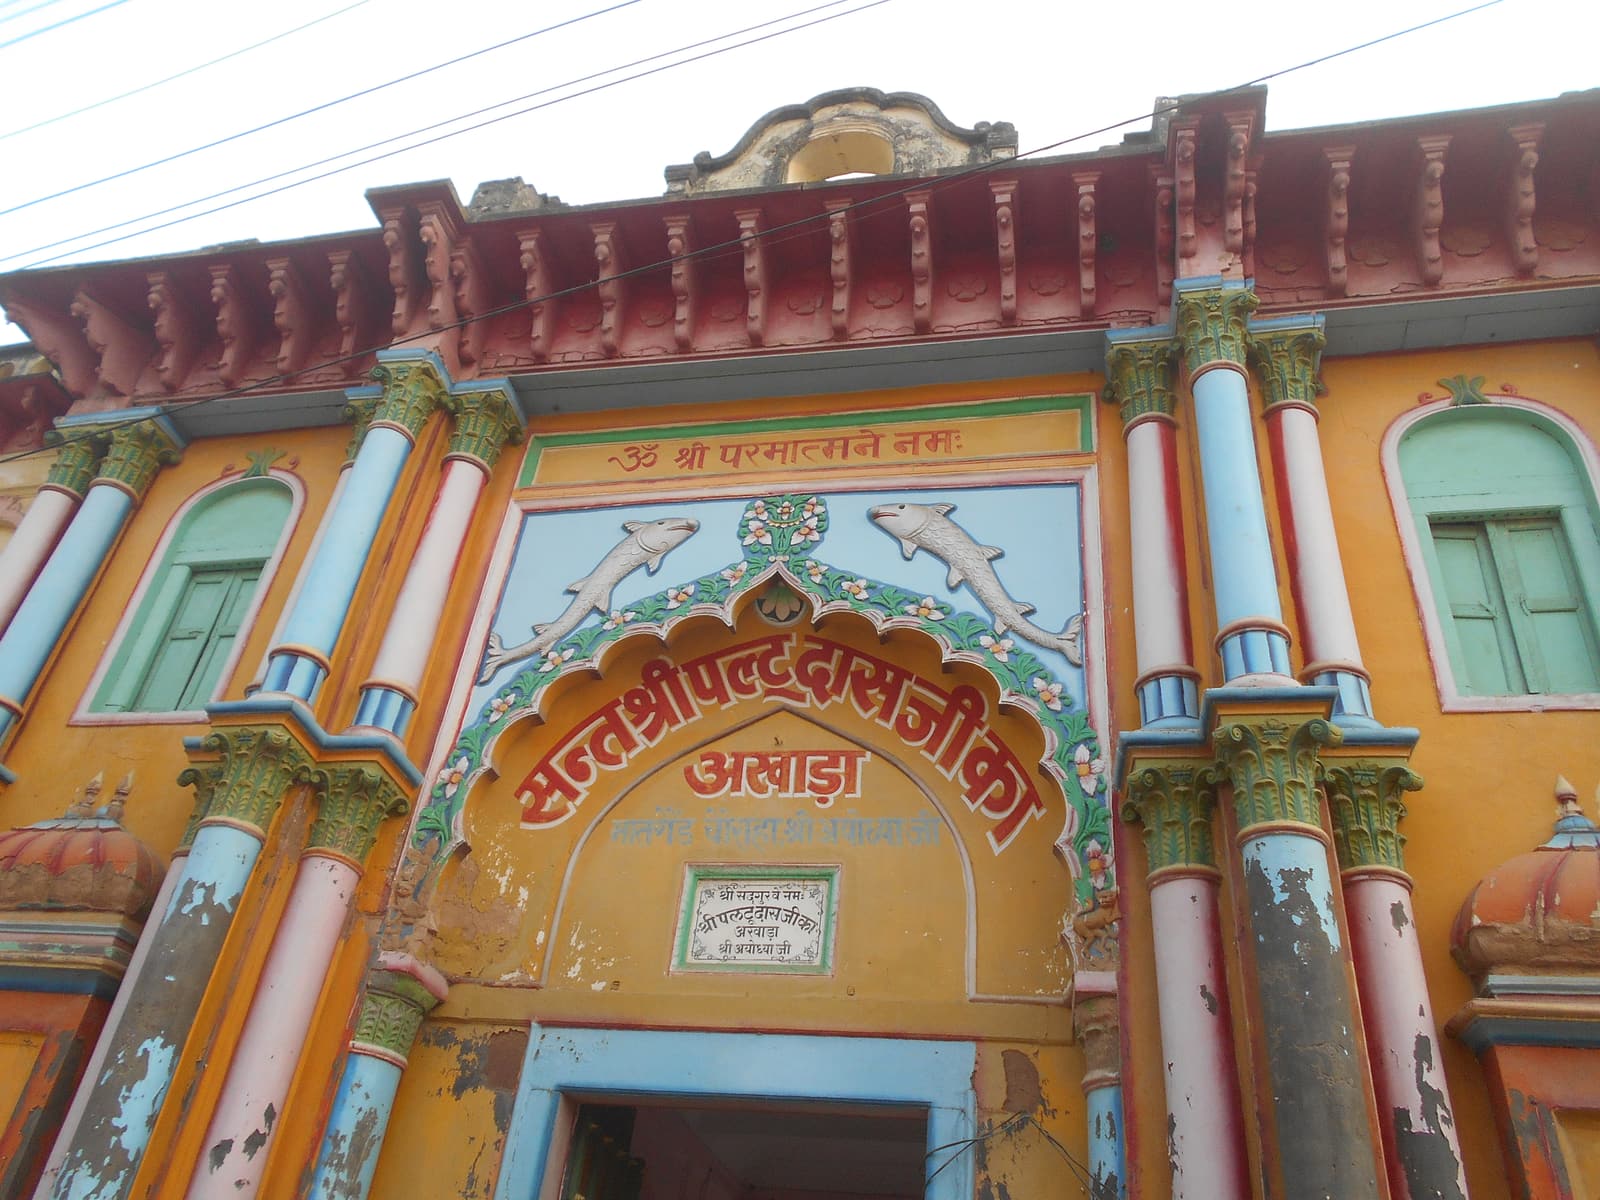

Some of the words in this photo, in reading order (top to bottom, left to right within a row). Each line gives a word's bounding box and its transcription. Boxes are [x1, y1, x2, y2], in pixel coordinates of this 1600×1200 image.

[673, 440, 711, 471] श्री
[719, 428, 886, 469] परमात्मने
[894, 428, 965, 457] नमः
[622, 656, 703, 748] श्री
[957, 724, 1047, 857] का
[683, 750, 872, 809] अखाड़ा
[720, 887, 734, 901] श्री
[783, 890, 804, 901] नमः
[698, 913, 717, 933] श्री
[719, 940, 733, 955] श्री
[775, 940, 792, 955] जी
